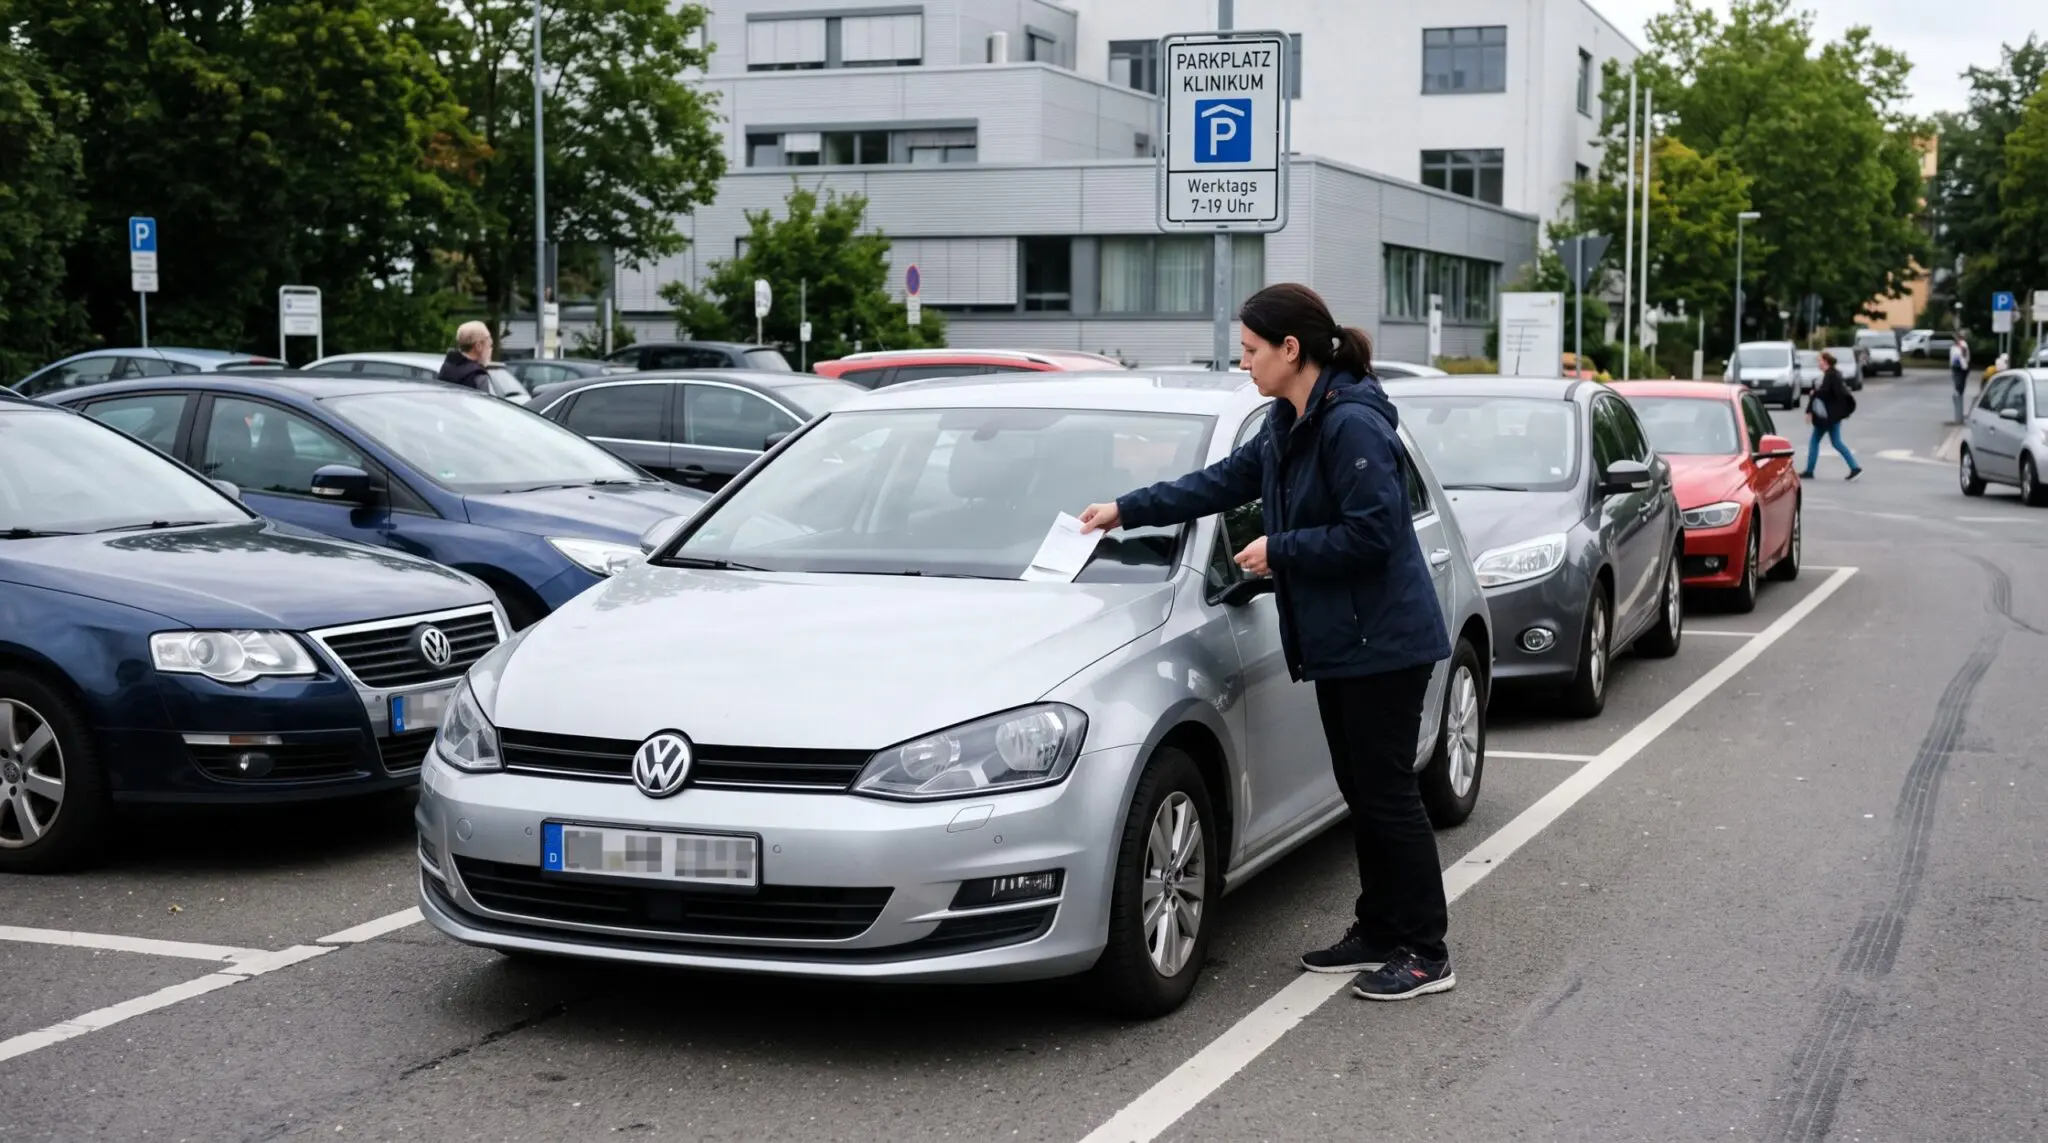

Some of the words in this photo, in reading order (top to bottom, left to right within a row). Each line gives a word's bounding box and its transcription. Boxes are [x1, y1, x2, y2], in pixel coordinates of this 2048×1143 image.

[1176, 51, 1271, 70] PARKPLATZ
[1183, 74, 1264, 92] KLINIKUM
[1210, 117, 1237, 156] P
[1187, 178, 1258, 197] Werktags
[1191, 198, 1222, 214] 7-19
[1226, 198, 1255, 213] Uhr
[135, 222, 149, 248] P
[423, 630, 450, 665] VW
[635, 737, 689, 793] VW
[549, 852, 557, 863] D
